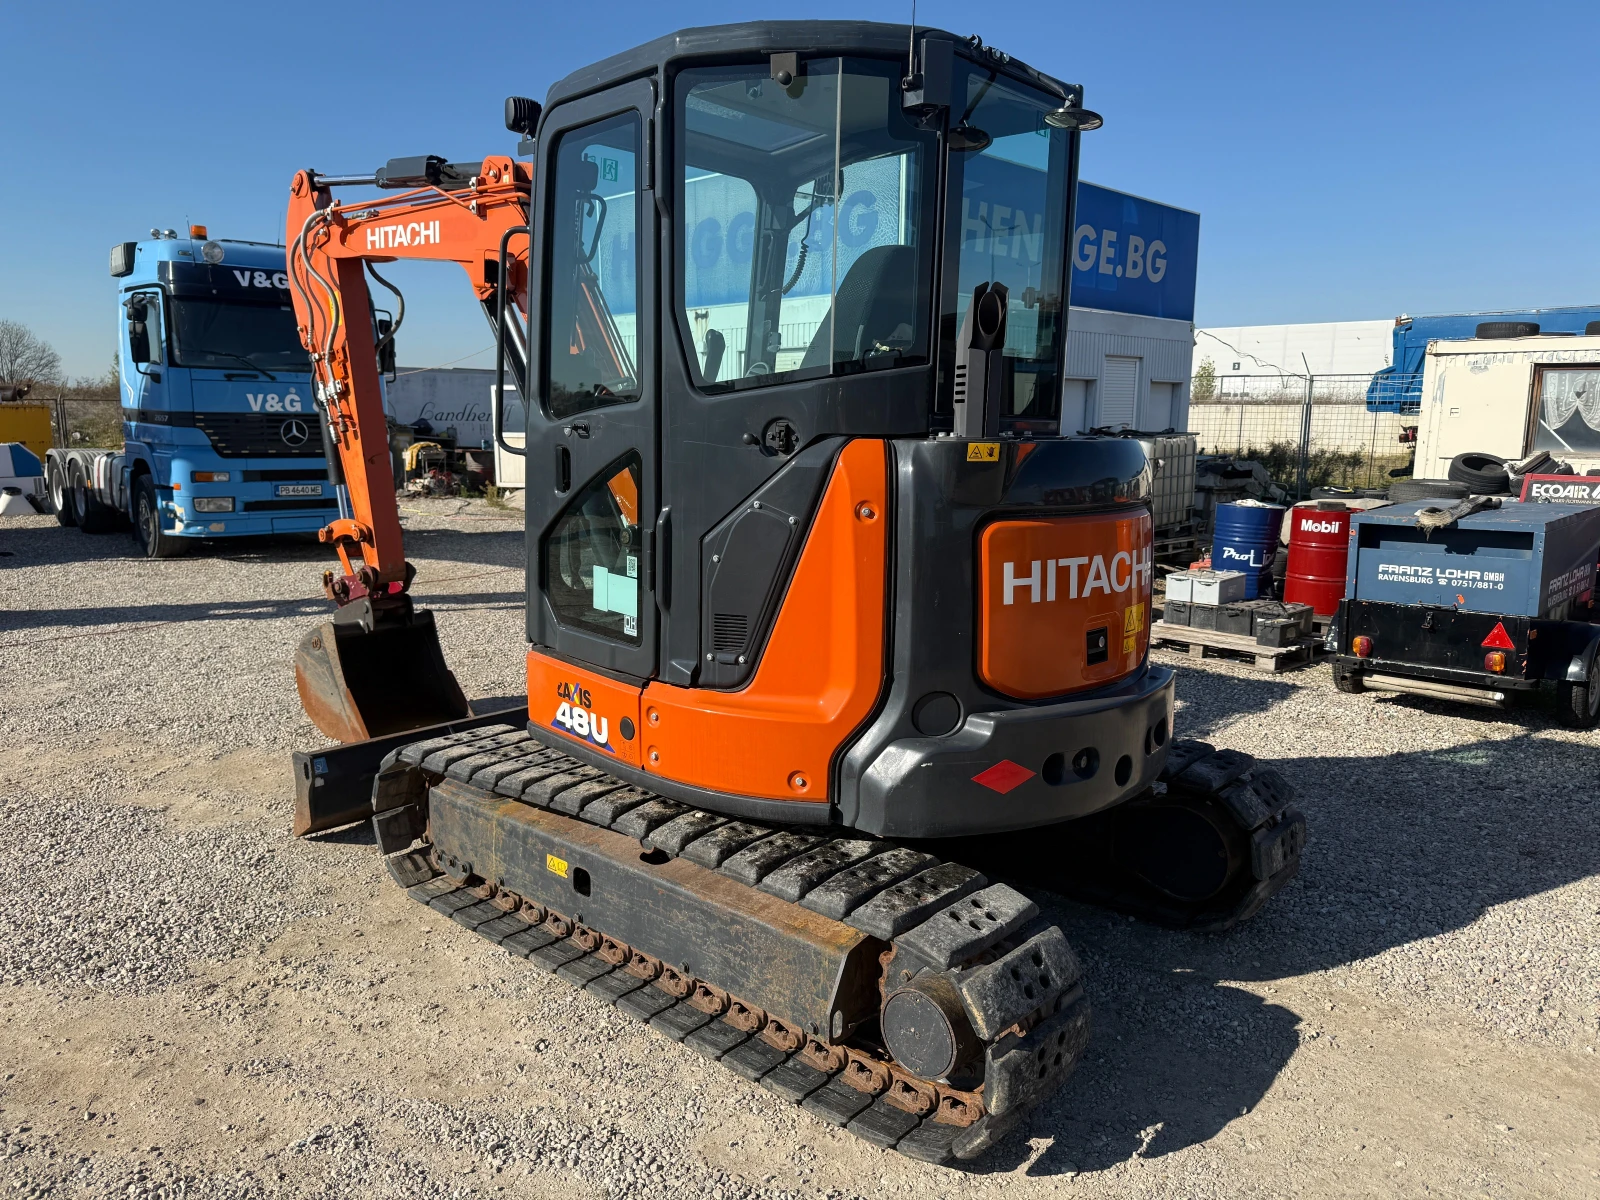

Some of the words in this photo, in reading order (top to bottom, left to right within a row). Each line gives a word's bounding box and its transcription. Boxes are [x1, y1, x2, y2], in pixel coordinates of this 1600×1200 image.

[366, 220, 440, 250] HITACHI
[961, 197, 1167, 283] HENGE.BG
[246, 393, 301, 412] V&G
[280, 486, 290, 494] PB
[291, 486, 310, 494] 4640
[1531, 483, 1590, 498] ECOAIR
[1301, 519, 1339, 533] Mobil
[1003, 546, 1150, 606] HITACHI
[1378, 564, 1433, 576] FRANZ
[1436, 568, 1481, 580] LOHR
[1483, 571, 1505, 582] GMBH
[1378, 573, 1434, 585] RAVENSBURG
[1451, 580, 1504, 590] 0751/881-0
[556, 701, 608, 744] 48U
